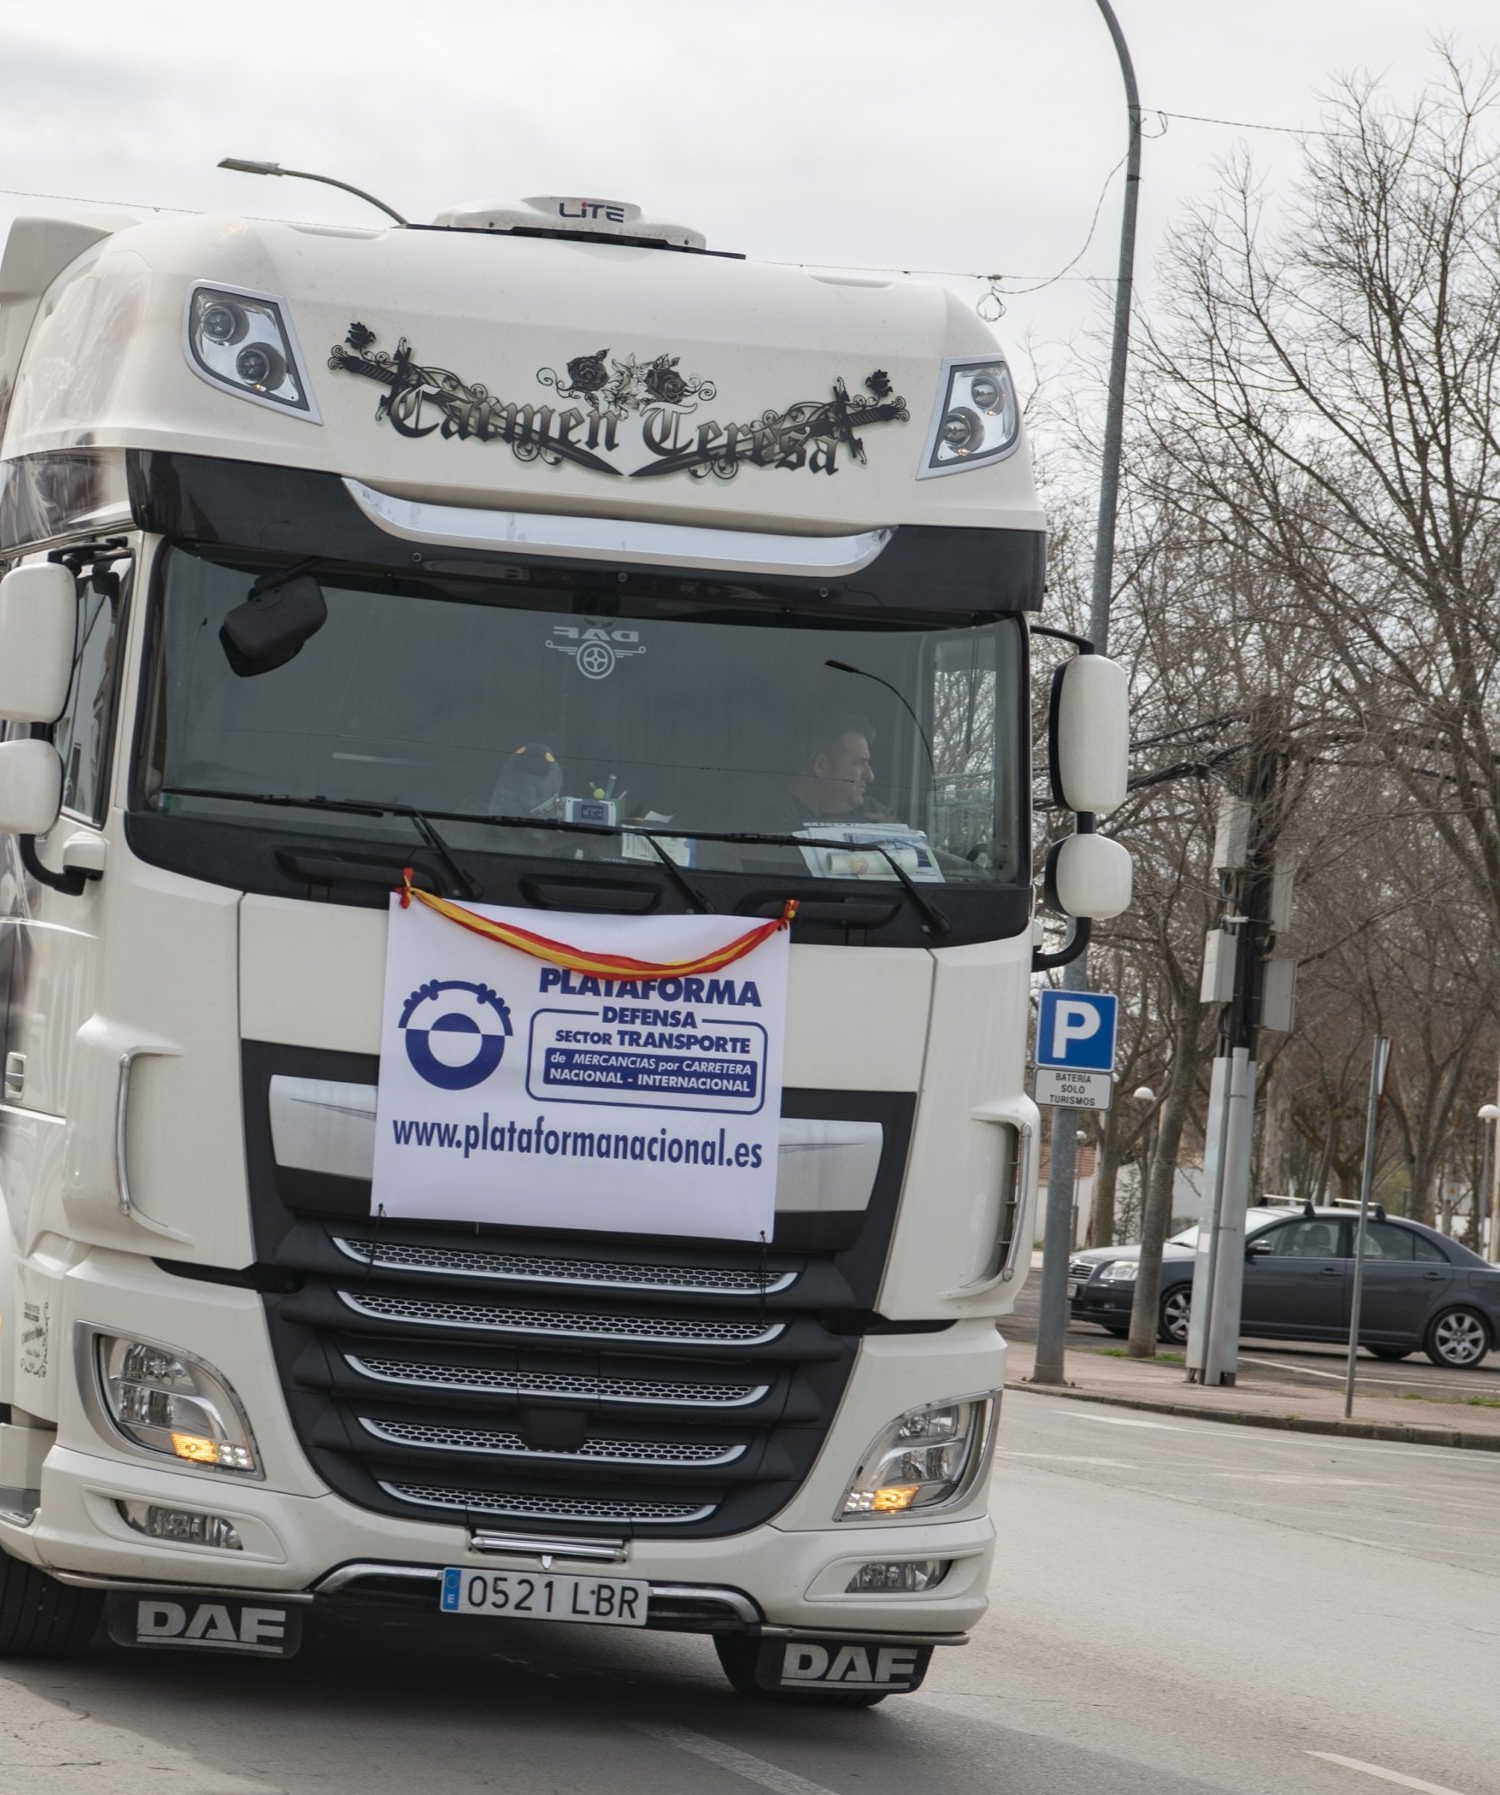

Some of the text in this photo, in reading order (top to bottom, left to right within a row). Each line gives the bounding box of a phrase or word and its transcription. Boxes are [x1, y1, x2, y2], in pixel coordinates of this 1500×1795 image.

[389, 383, 841, 476] Carmen Teresa
[539, 967, 762, 1007] PLATAFORMA
[602, 1006, 698, 1029] DEFENSA
[1052, 1000, 1101, 1059] P
[555, 1029, 751, 1054] SECTOR TRANSPORTE
[549, 1068, 624, 1084] NACIONAL
[637, 1074, 751, 1092] INTERNACIONAL
[550, 1051, 752, 1076] de MERCANCIAS por CARRETERA
[1050, 1094, 1096, 1107] TURISMOS
[1061, 1084, 1085, 1095] SOLO
[392, 1112, 763, 1169] www.plataformanacional.es
[468, 1575, 555, 1613] 0521
[572, 1582, 639, 1619] LBR
[137, 1600, 287, 1645] DAF
[781, 1643, 919, 1683] DAF
